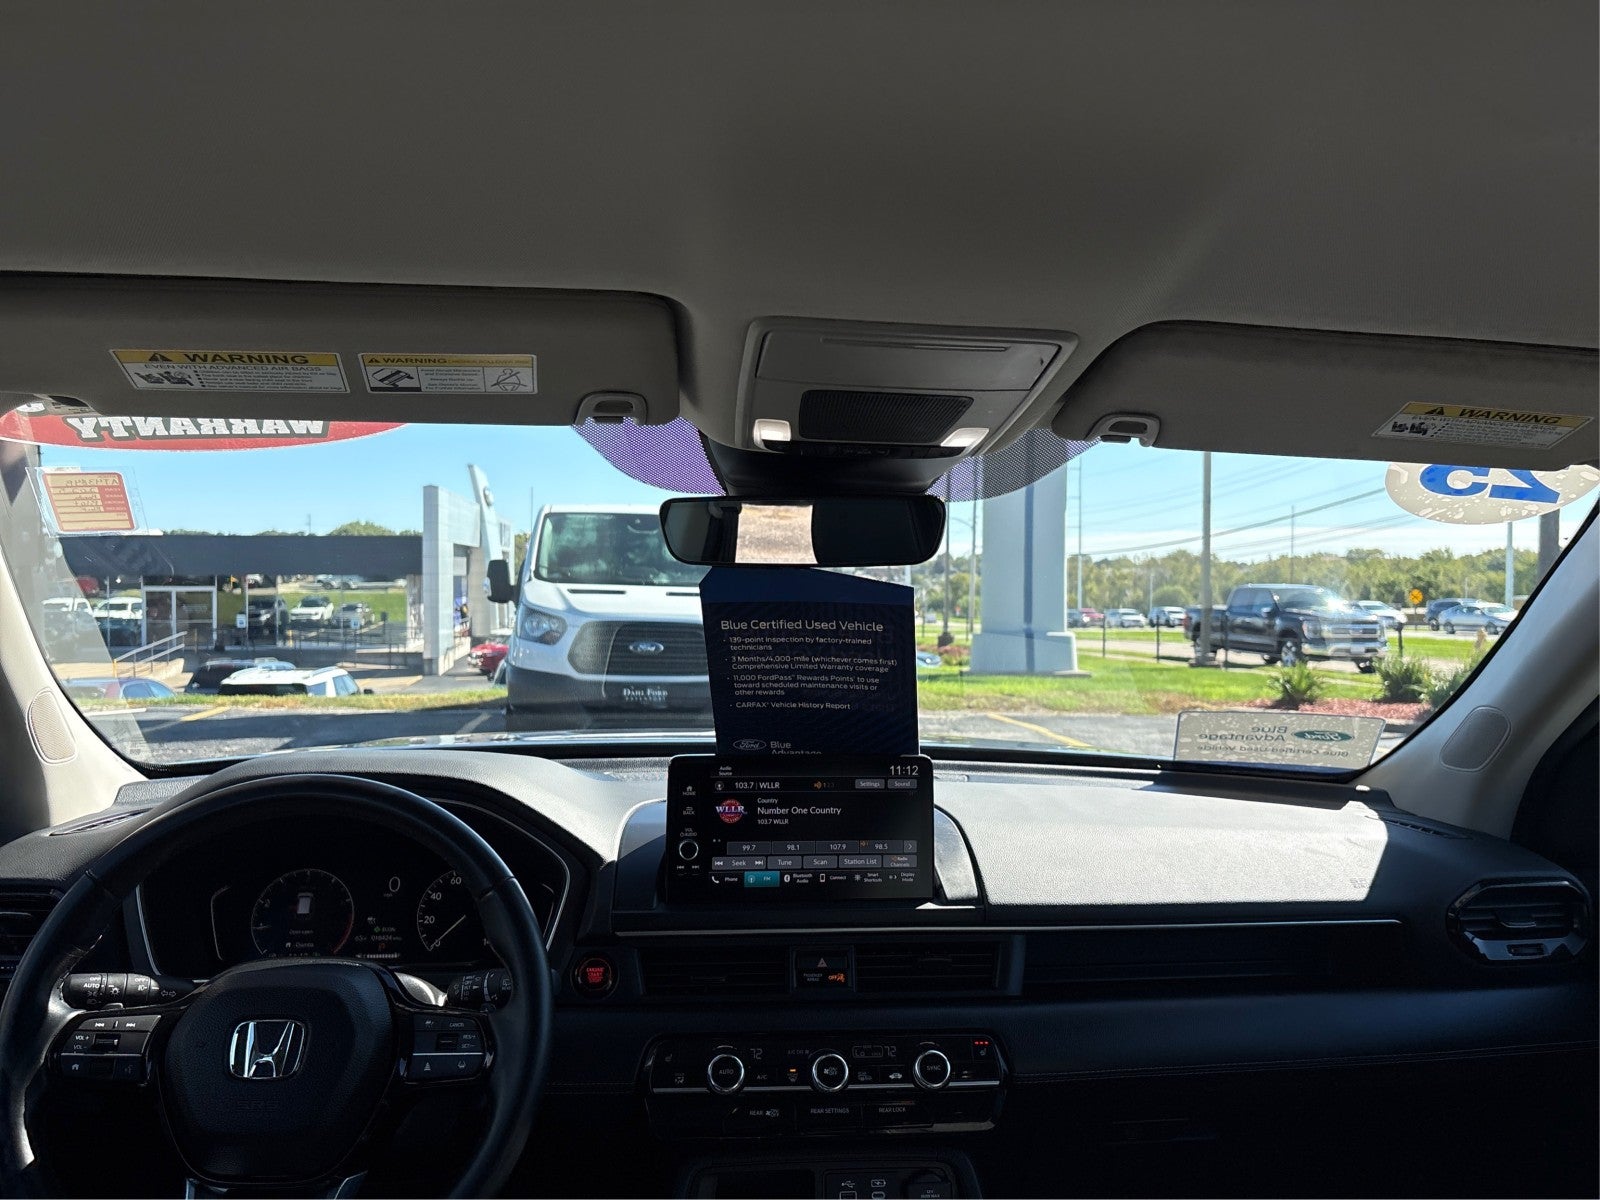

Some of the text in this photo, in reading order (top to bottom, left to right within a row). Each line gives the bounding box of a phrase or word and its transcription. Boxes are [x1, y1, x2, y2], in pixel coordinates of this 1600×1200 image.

[184, 354, 309, 364] WARNING
[1458, 408, 1562, 424] WARNING
[721, 619, 884, 632] Blue Certified Used Vehicle
[729, 636, 872, 645] 139-point inspection by factory-trained
[811, 655, 851, 663] (whichever
[880, 658, 897, 666] first)
[820, 663, 853, 671] Warranty
[855, 665, 889, 673] coverage
[866, 676, 880, 684] use
[801, 682, 848, 690] maintenance
[770, 741, 791, 749] Blue
[890, 765, 919, 776] 11:12
[735, 781, 780, 789] 103.7 WLLR
[715, 805, 745, 813] WLLR
[757, 806, 842, 816] Number One Country
[389, 876, 400, 892] 0
[450, 876, 462, 885] 60
[430, 892, 442, 900] 40
[424, 915, 435, 924] 20
[750, 1048, 762, 1060] 72
